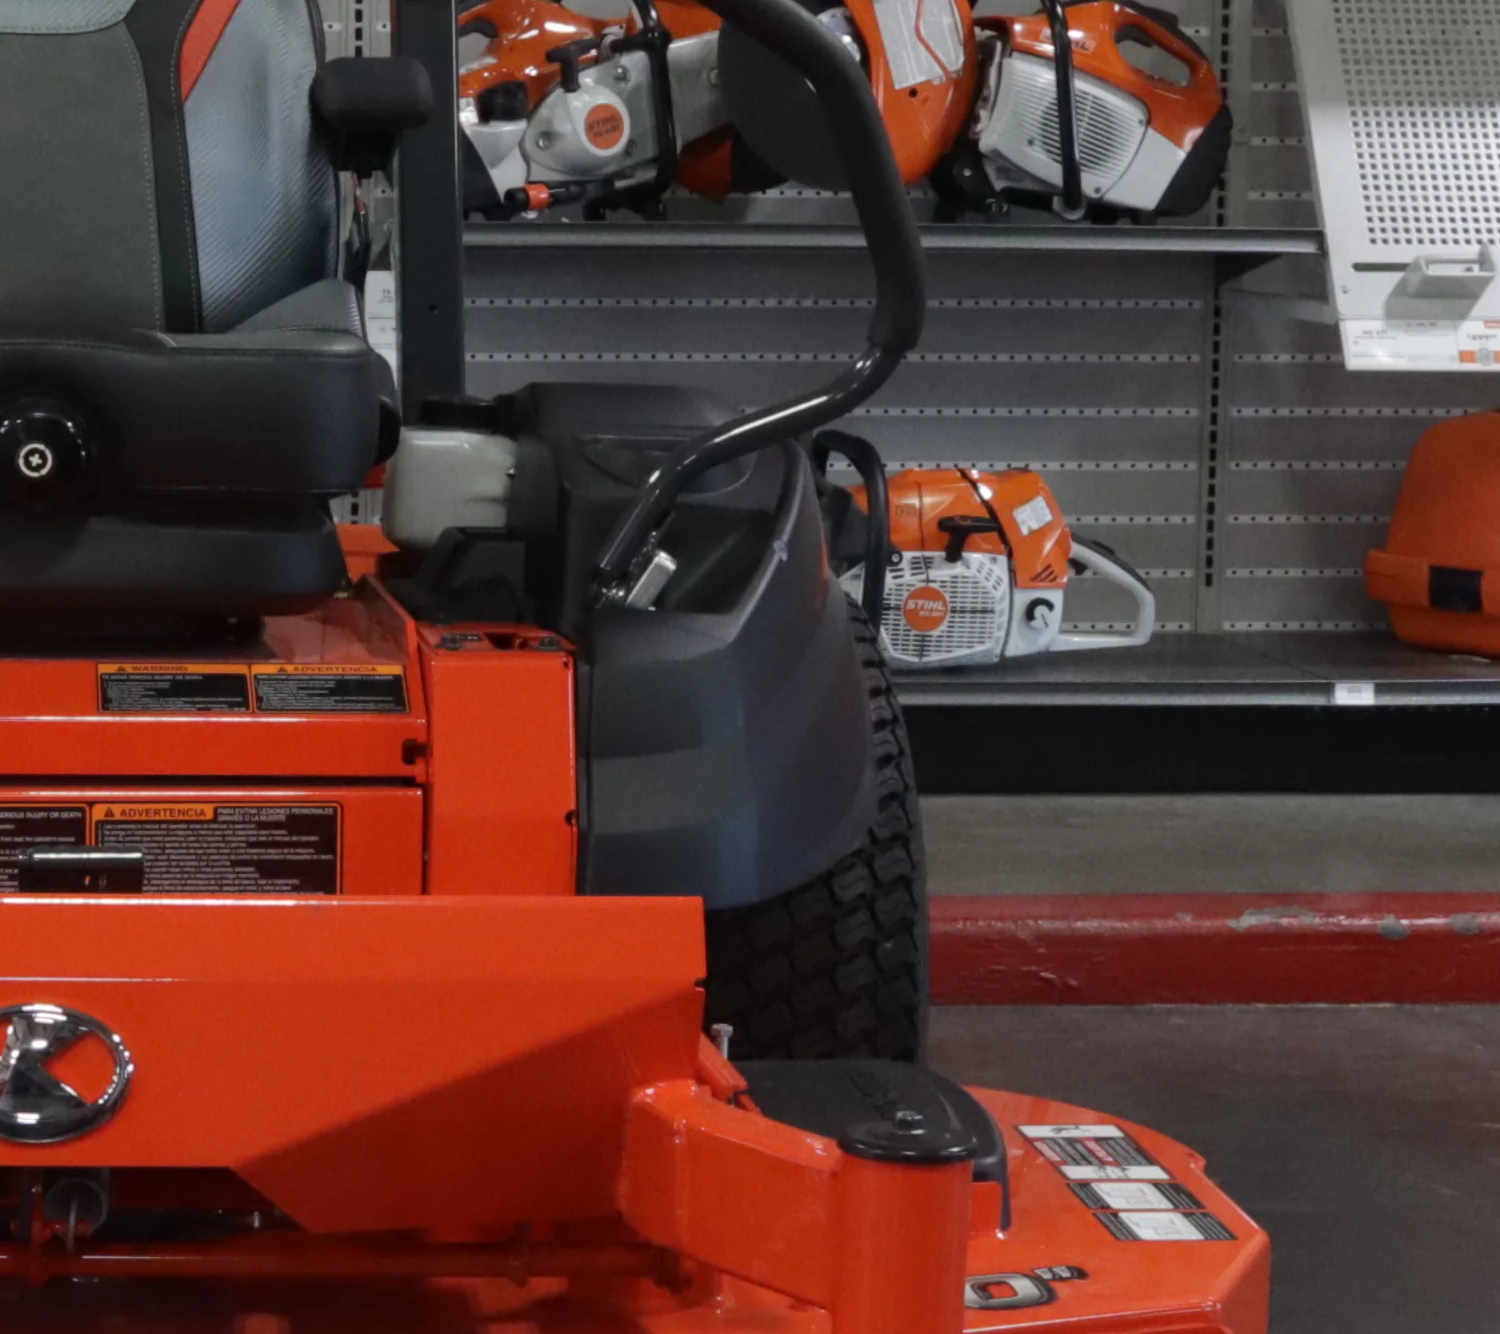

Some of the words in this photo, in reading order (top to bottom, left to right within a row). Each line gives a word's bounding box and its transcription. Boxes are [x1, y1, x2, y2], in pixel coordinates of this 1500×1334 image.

[906, 599, 946, 611] STIHL
[292, 666, 378, 674] ADVERTENCIA
[119, 808, 207, 819] ADVERTENCIA
[291, 807, 334, 815] PERSONALES
